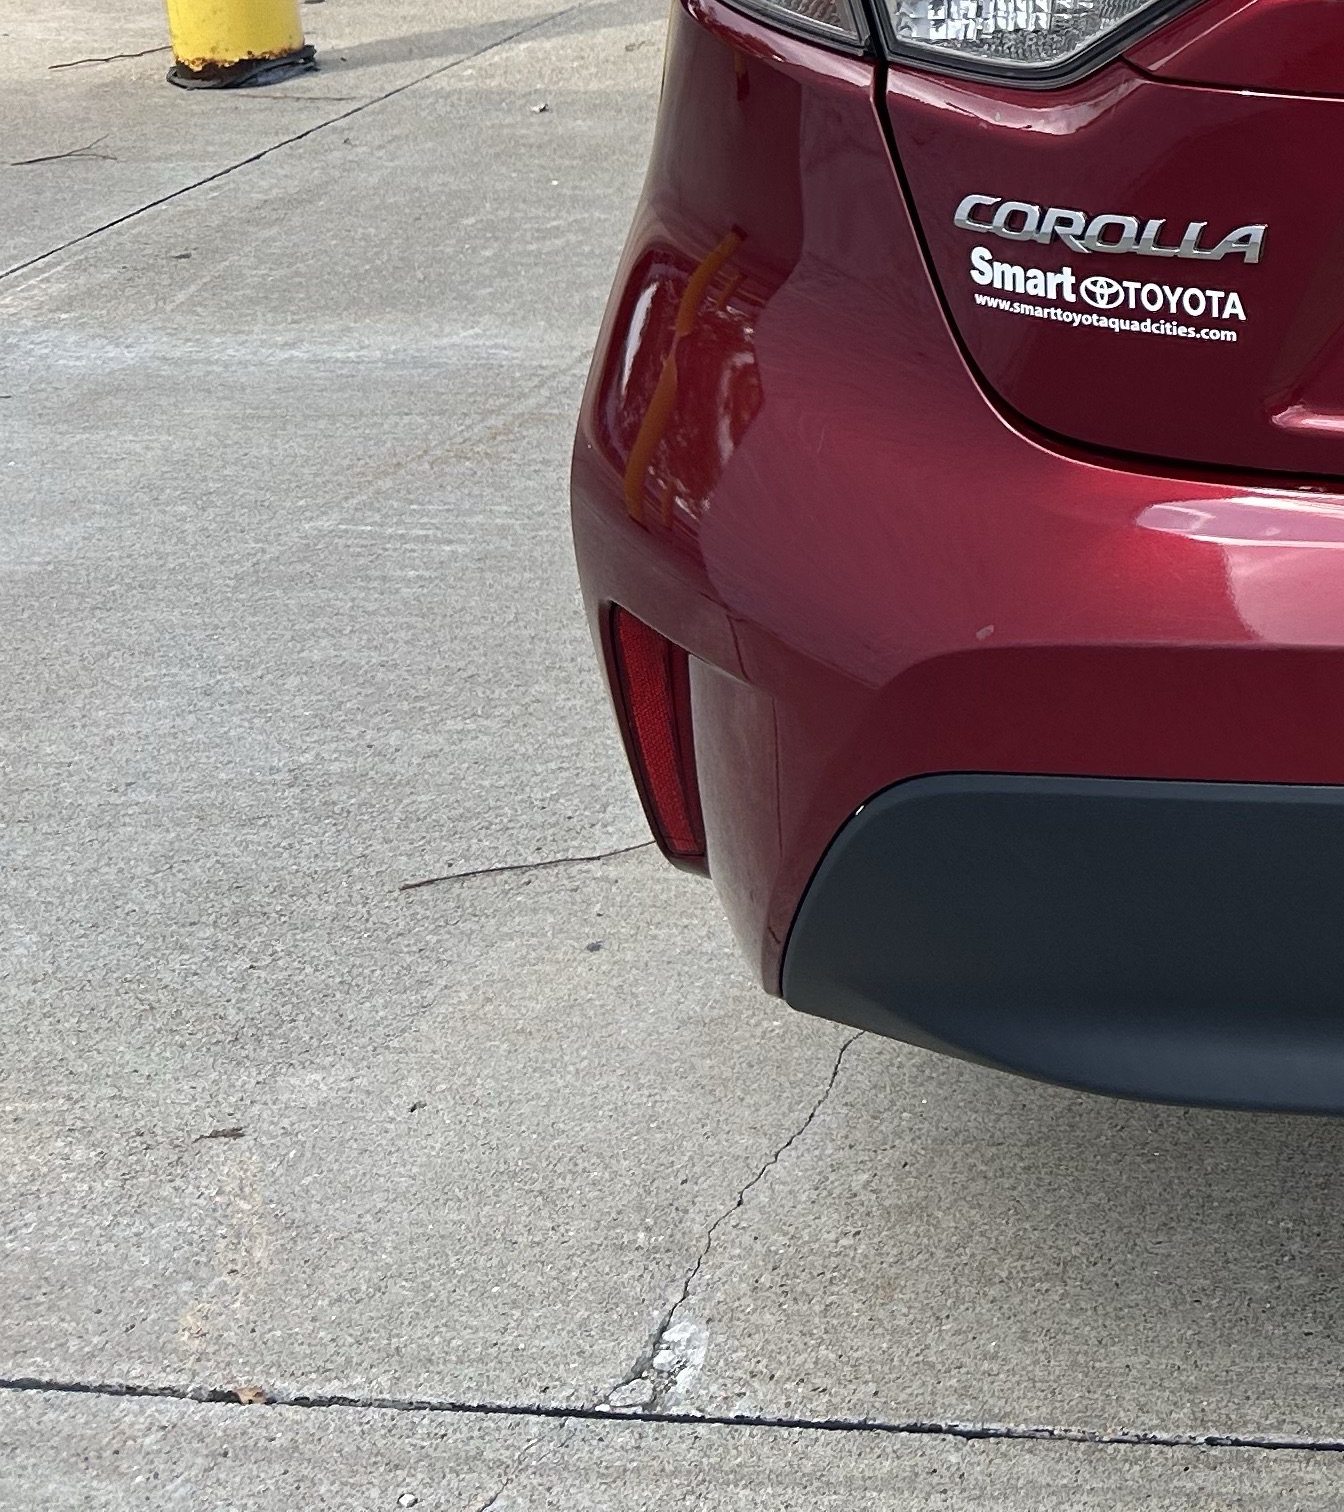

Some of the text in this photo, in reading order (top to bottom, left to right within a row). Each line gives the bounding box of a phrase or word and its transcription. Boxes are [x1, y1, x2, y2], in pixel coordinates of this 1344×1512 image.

[953, 194, 1268, 264] COROLLA
[969, 245, 1247, 321] Smart TOYOTA
[974, 293, 1238, 343] www.smarttoyotaquadcities.com
